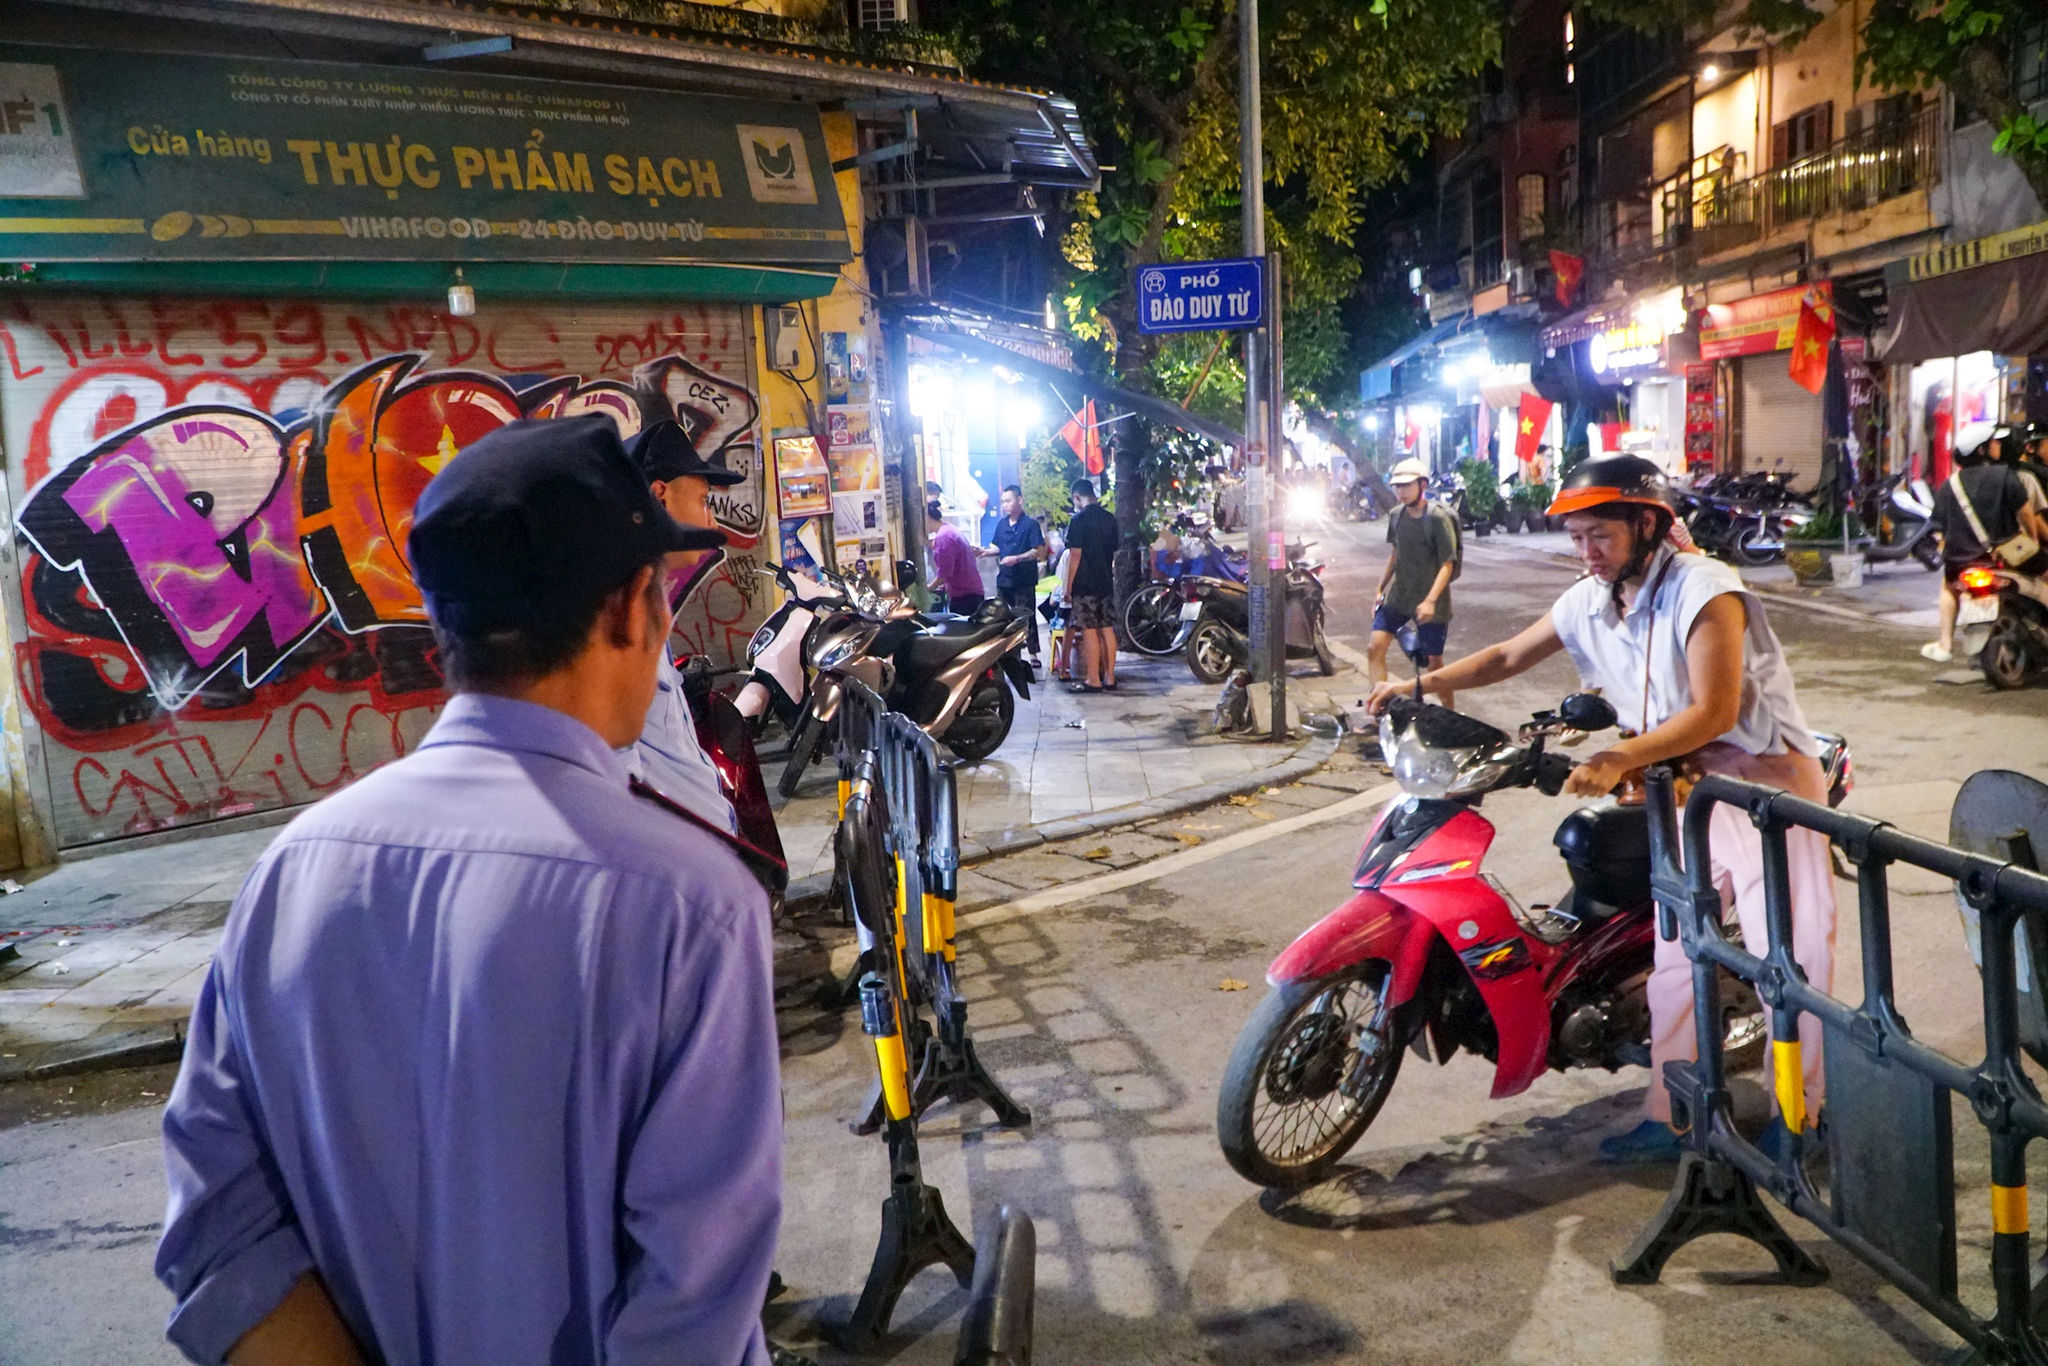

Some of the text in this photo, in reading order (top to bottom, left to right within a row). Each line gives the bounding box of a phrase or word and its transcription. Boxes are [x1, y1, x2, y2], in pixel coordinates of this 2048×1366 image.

[127, 124, 722, 207] Cửa hàng THỰC PHẨM SẠCH
[517, 218, 550, 240] 24
[556, 215, 616, 241] ĐÀO
[621, 222, 671, 241] DUY
[1180, 269, 1220, 289] PHỐ
[1151, 287, 1252, 322] ĐÀO DUY TỪ
